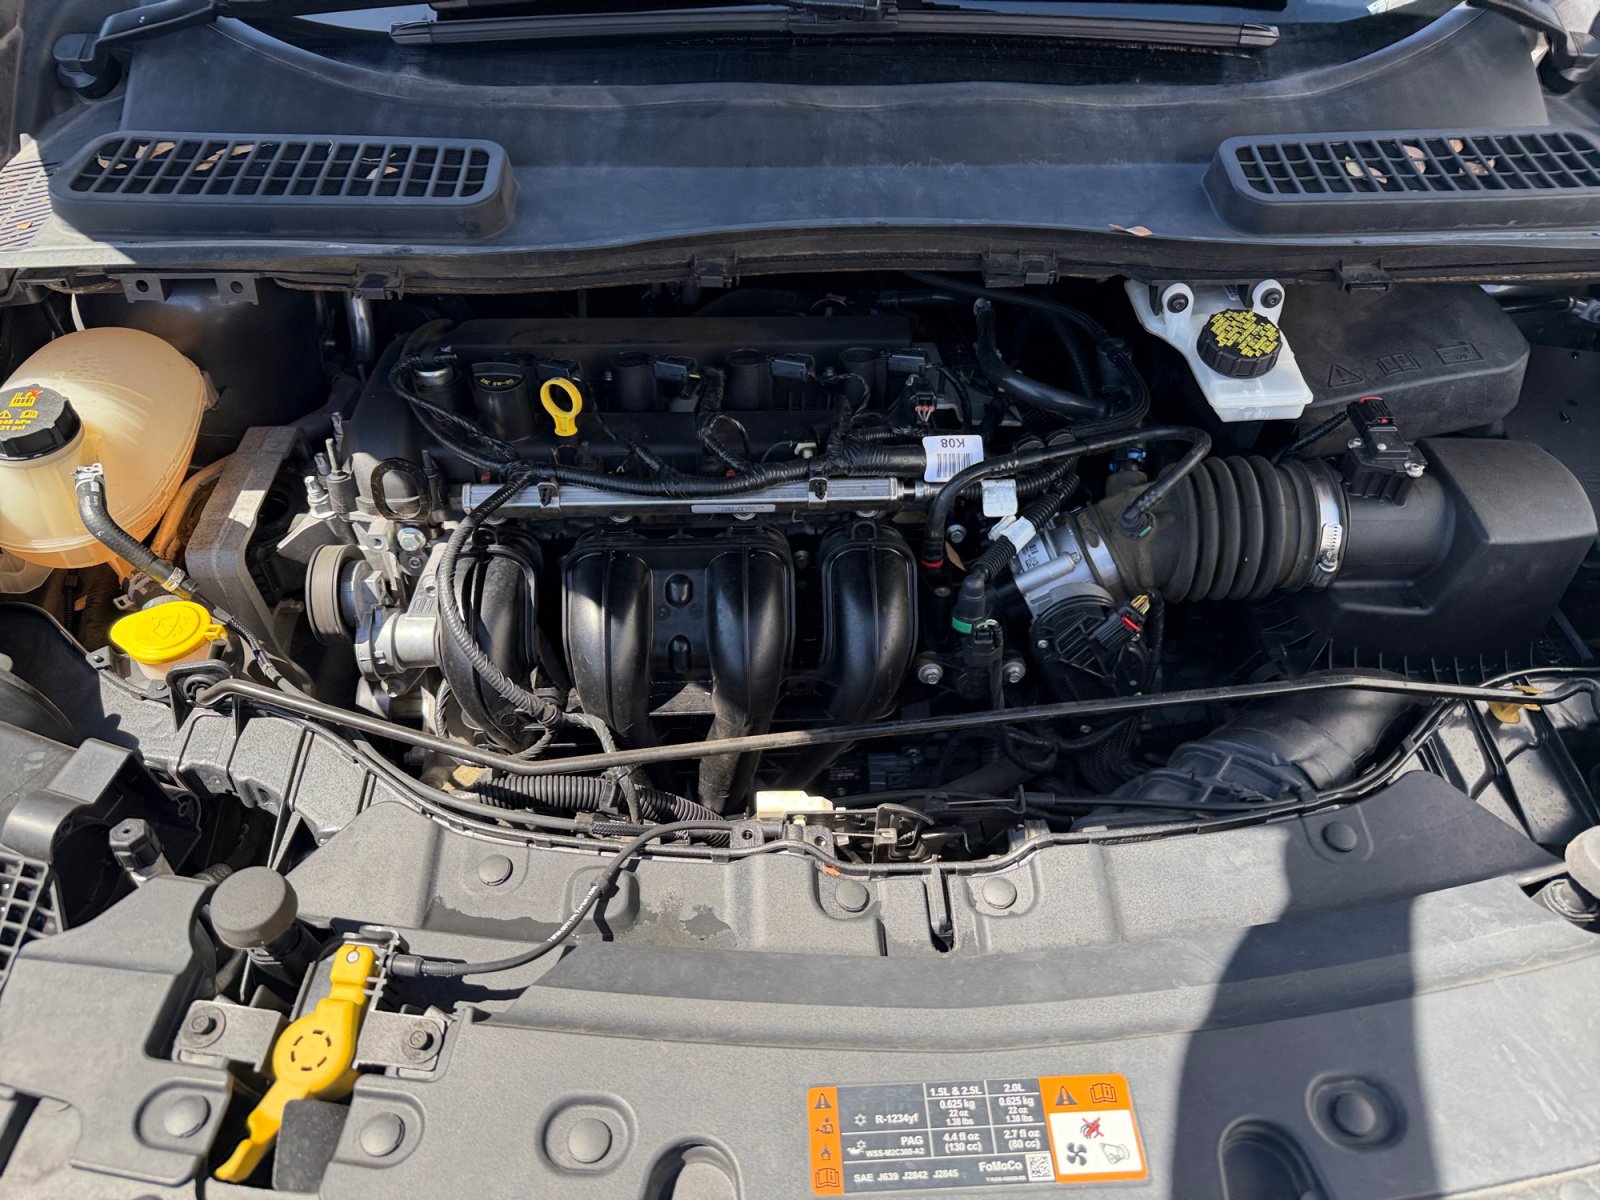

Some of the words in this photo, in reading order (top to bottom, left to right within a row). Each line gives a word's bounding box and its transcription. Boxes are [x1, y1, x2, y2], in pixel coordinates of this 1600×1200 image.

[941, 438, 965, 448] K08
[930, 1088, 950, 1096] 1.5L
[952, 1087, 960, 1095] &
[961, 1086, 982, 1095] 2.5L
[1004, 1083, 1025, 1092] 2.0L
[940, 1100, 963, 1109] 0.625
[964, 1099, 975, 1110] kg
[999, 1097, 1022, 1106] 0.625
[1023, 1096, 1034, 1106] kg
[1008, 1106, 1017, 1114] 22
[875, 1113, 919, 1124] R-1234yf
[946, 1118, 961, 1126] 1.38
[943, 1133, 957, 1141] 4.4
[959, 1132, 966, 1140] fl
[1004, 1130, 1018, 1139] 2.7
[1019, 1129, 1027, 1137] fl
[901, 1136, 924, 1146] PAG
[1009, 1139, 1024, 1150] (80
[1025, 1138, 1040, 1149] cc)
[945, 1143, 965, 1153] (130
[967, 1141, 982, 1152] cc)
[978, 1160, 1023, 1172] FoMoCo
[854, 1174, 874, 1182] SAE
[877, 1172, 899, 1181] J639
[902, 1171, 928, 1180] J2842
[933, 1169, 959, 1178] J2845
